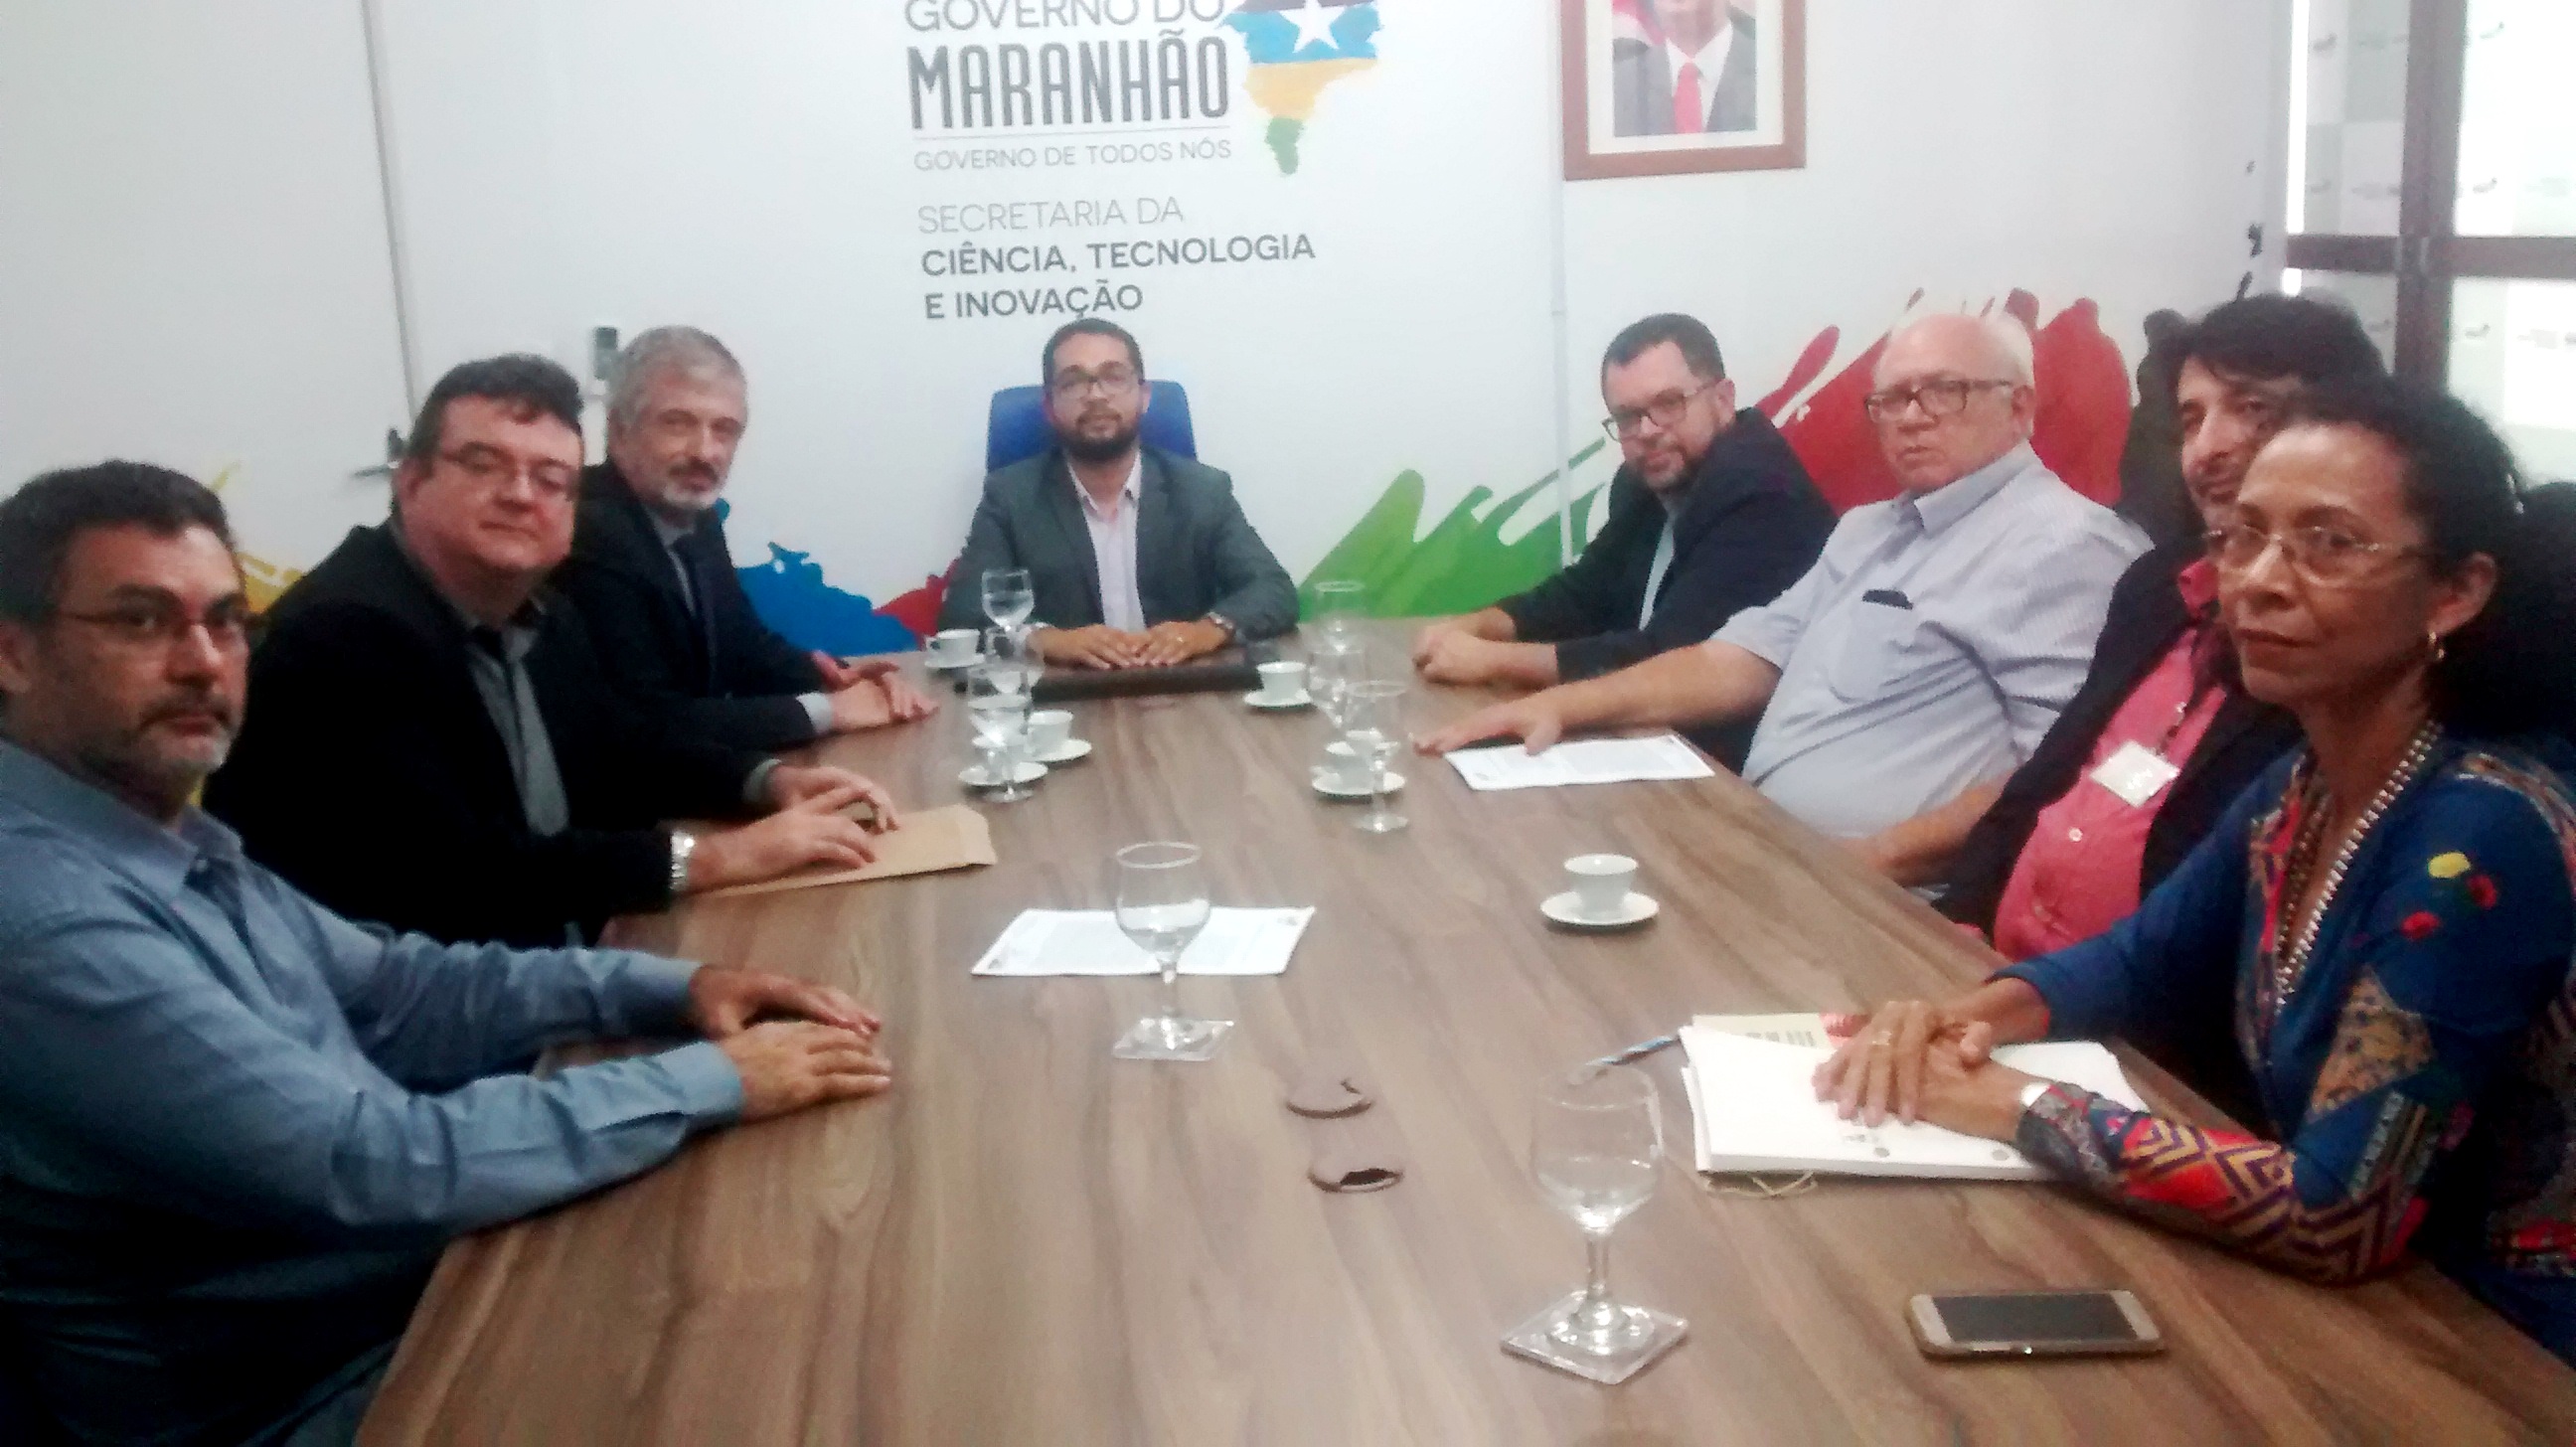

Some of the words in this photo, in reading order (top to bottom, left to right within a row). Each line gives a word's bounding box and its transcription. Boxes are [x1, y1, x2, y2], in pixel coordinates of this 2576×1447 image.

[904, 0, 1139, 31] GOVERNO
[1154, 0, 1224, 23] DO
[907, 28, 1228, 129] MARANHÃO
[914, 148, 1037, 171] GOVERNO
[1045, 146, 1075, 166] DE
[1085, 142, 1173, 164] TODOS
[1181, 137, 1231, 160] NÓS
[918, 200, 1127, 235] SECRETARIA
[1137, 197, 1184, 225] DA
[922, 241, 1076, 276] CIÊNCIA,
[1086, 235, 1316, 268] TECNOLOGIA
[925, 293, 944, 319] E
[956, 279, 1143, 319] INOVAÇÃO
